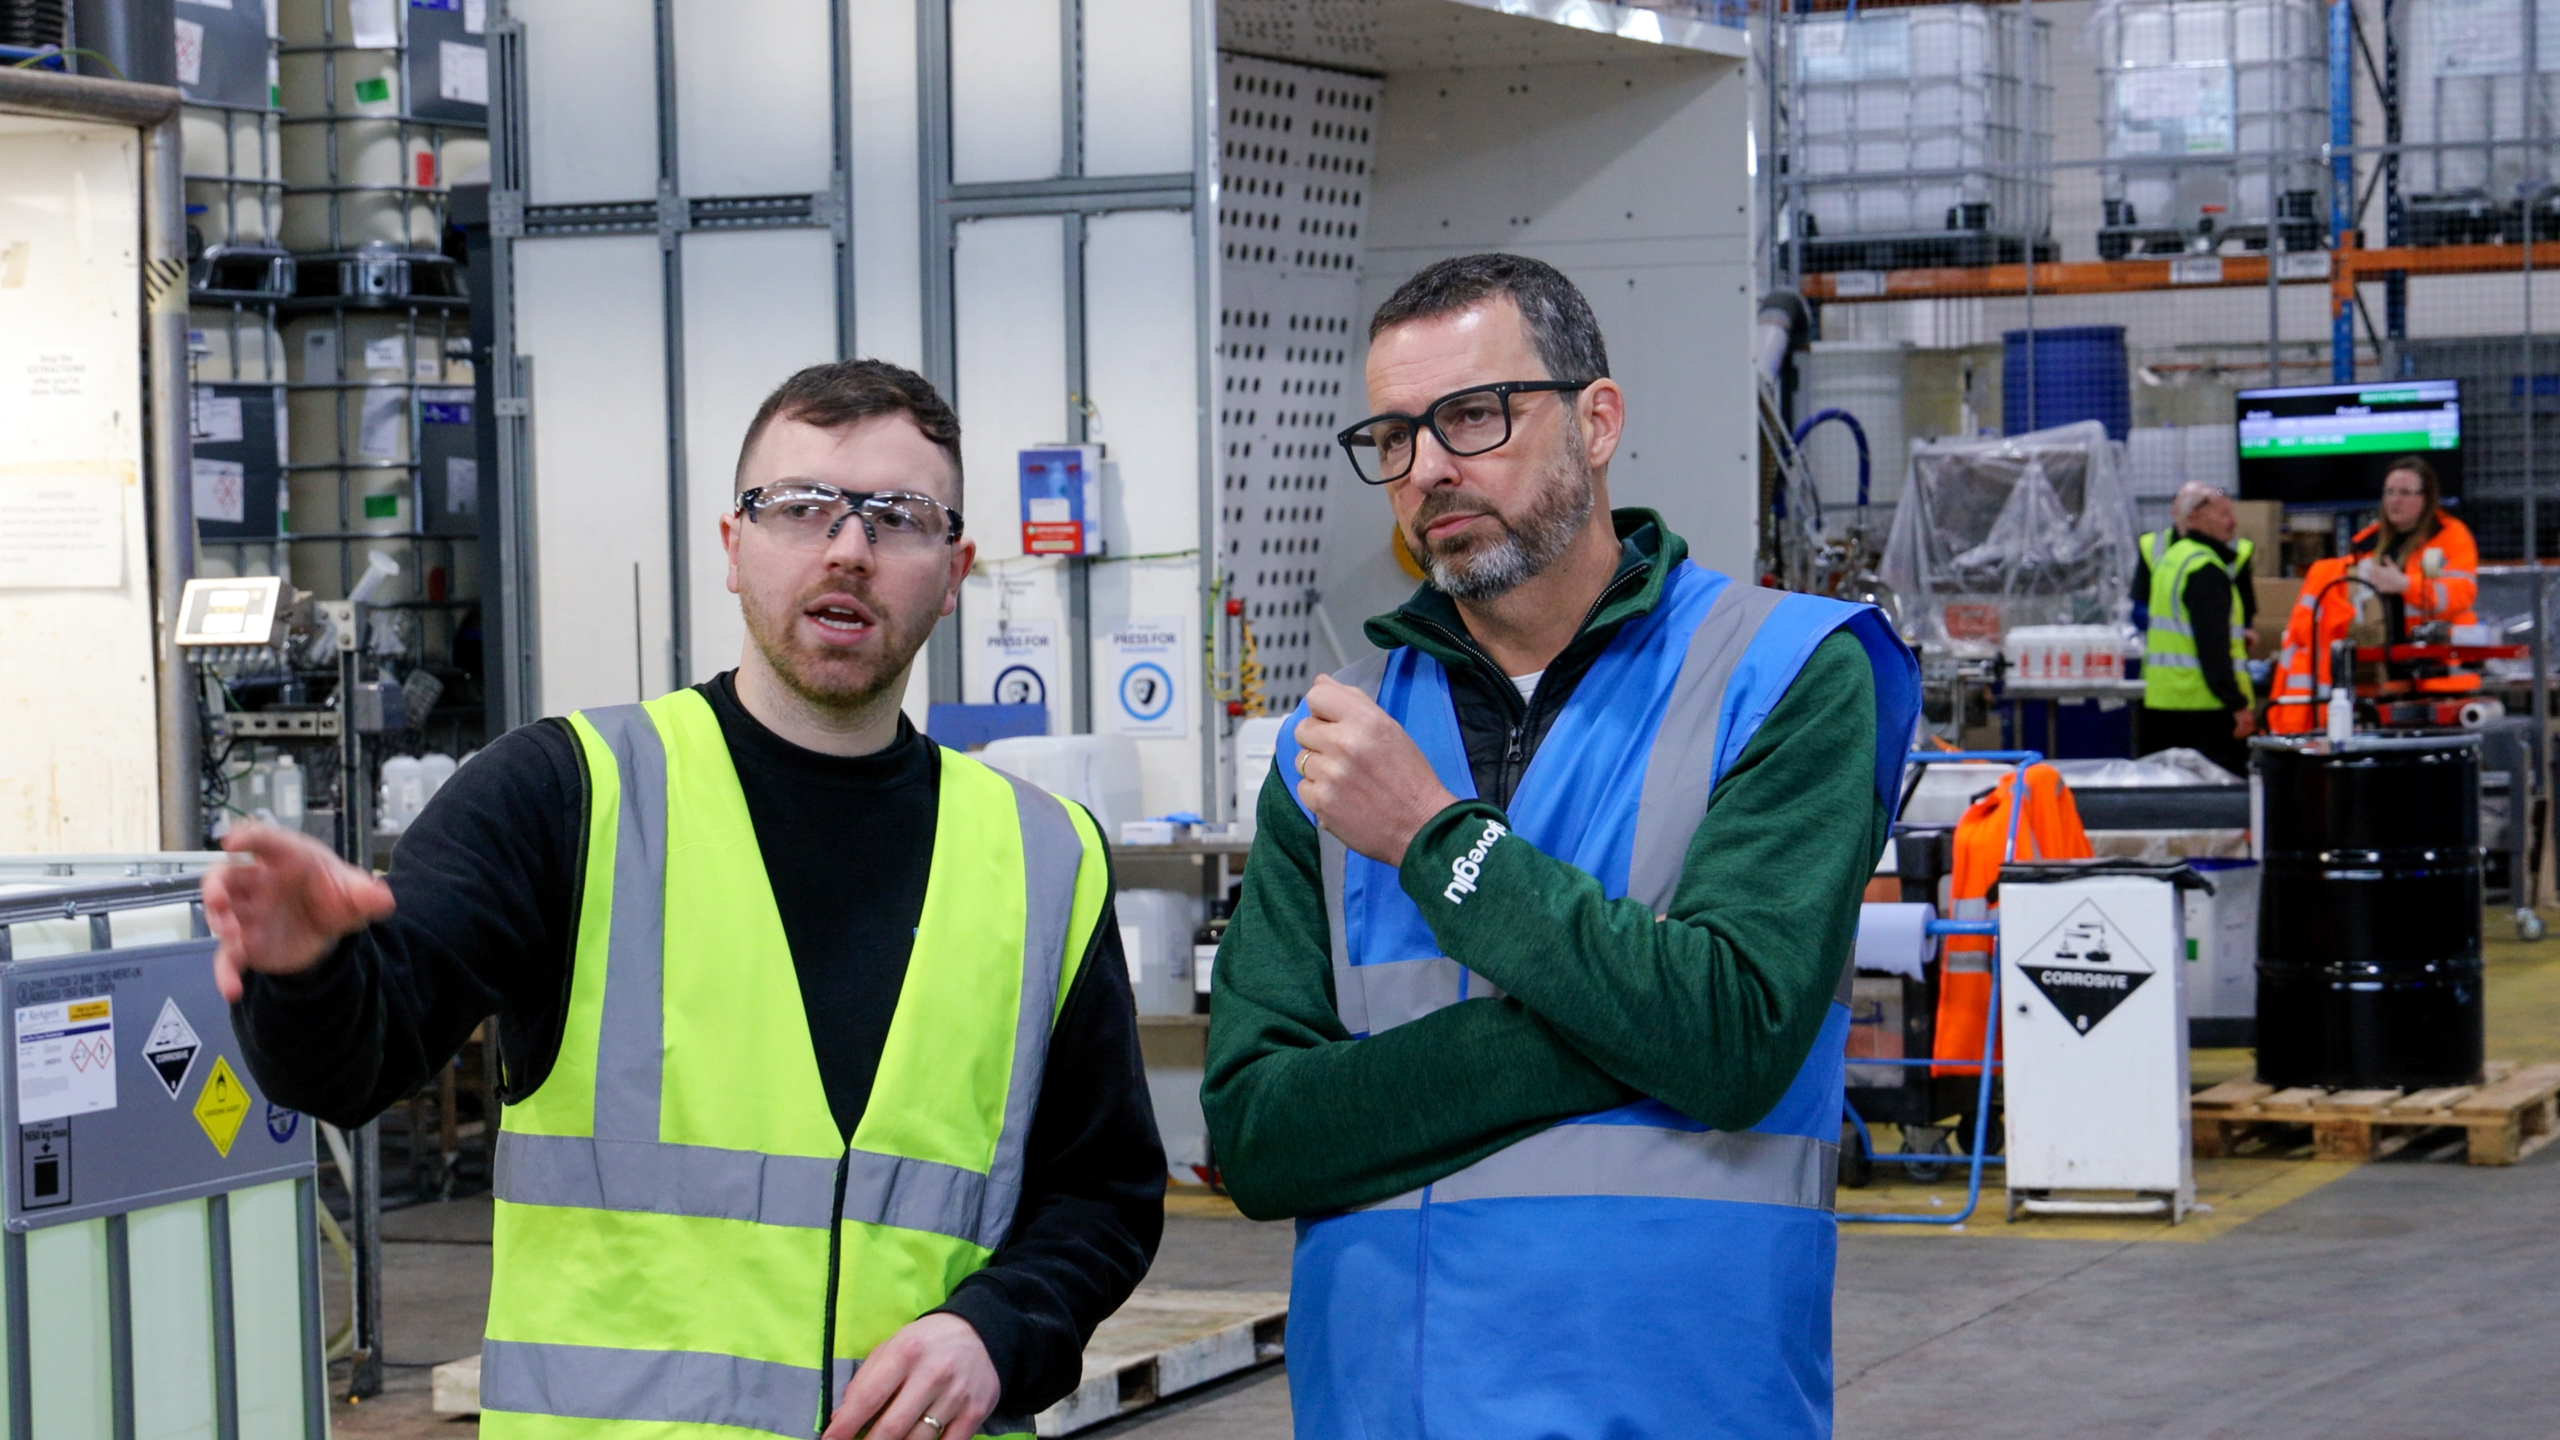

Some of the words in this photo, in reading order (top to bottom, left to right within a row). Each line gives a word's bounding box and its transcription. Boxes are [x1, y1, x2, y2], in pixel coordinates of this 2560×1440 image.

[1025, 635, 1049, 645] FOR
[1113, 633, 1149, 644] PRESS
[1151, 632, 1177, 643] FOR
[2040, 970, 2129, 989] CORROSIVE
[2076, 1015, 2089, 1030] 8
[155, 1049, 189, 1064] CORROSIVE
